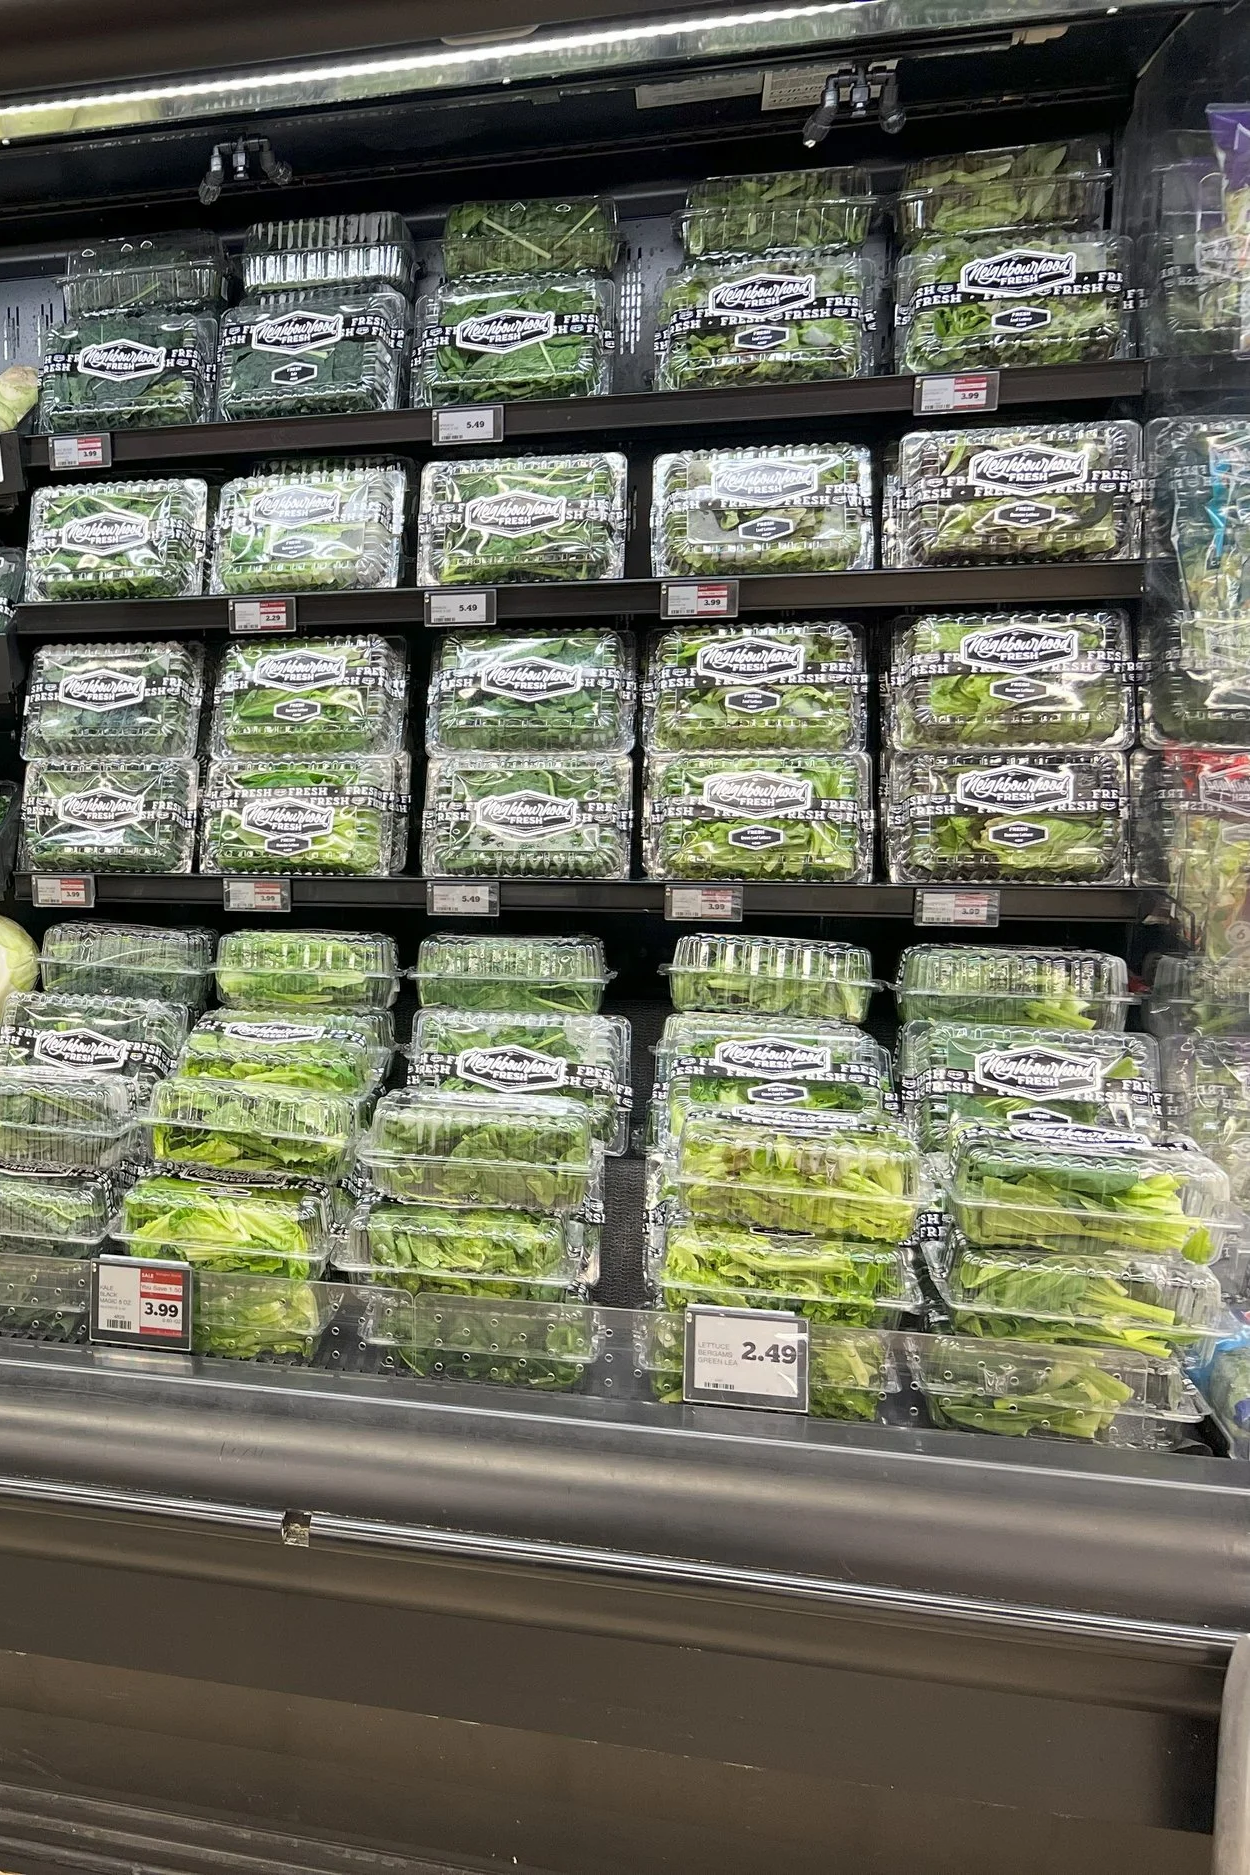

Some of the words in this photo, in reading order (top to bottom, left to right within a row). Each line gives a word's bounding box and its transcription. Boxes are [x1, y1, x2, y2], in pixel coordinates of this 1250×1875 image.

[970, 256, 1070, 282] Neighbourhood
[1000, 275, 1038, 285] FRESH
[715, 279, 811, 306] Neighbourhood
[1053, 284, 1103, 295] FRESH
[745, 298, 781, 308] FRESH
[785, 308, 831, 320] FRESH
[257, 317, 339, 342] Neighbourhood
[462, 317, 549, 340] Neighbourhood
[281, 334, 310, 344] FRESH
[489, 333, 521, 342] FRESH
[85, 348, 161, 367] Neighbourhood
[106, 363, 135, 371] FRESH
[961, 392, 979, 400] 3.99
[466, 420, 485, 429] 5.49
[977, 454, 1081, 479] Neighbourhood
[1009, 472, 1050, 482] FRESH
[747, 485, 782, 494] FRESH
[472, 501, 559, 523] Neighbourhood
[498, 516, 531, 525] FRESH
[968, 634, 1071, 658] Neighbourhood
[703, 645, 800, 668] Neighbourhood
[1000, 651, 1038, 661] FRESH
[260, 660, 340, 680] Neighbourhood
[732, 663, 768, 671] FRESH
[284, 673, 314, 681] FRESH
[486, 665, 576, 686] Neighbourhood
[65, 679, 140, 697] Neighbourhood
[513, 681, 547, 690] FRESH
[87, 693, 115, 701] FRESH
[966, 773, 1069, 797] Neighbourhood
[234, 789, 271, 798] FRESH
[288, 787, 327, 797] FRESH
[711, 780, 808, 802] Neighbourhood
[996, 791, 1035, 801] FRESH
[65, 797, 138, 816] Neighbourhood
[310, 797, 349, 806] FRESH
[740, 798, 775, 807] FRESH
[483, 800, 571, 820] Neighbourhood
[87, 812, 115, 820] FRESH
[248, 805, 329, 827] Neighbourhood
[510, 816, 543, 824] FRESH
[271, 823, 303, 831] FRESH
[42, 1035, 122, 1060] Neighbourhood
[64, 1052, 94, 1062] FRESH
[724, 1044, 825, 1065] Neighbourhood
[464, 1050, 561, 1077] Neighbourhood
[755, 1060, 790, 1068] FRESH
[984, 1055, 1095, 1080] Neighbourhood
[492, 1070, 528, 1080] FRESH
[1017, 1077, 1059, 1087] FRESH
[144, 1302, 179, 1317] 3.99
[698, 1342, 730, 1350] LETTUCE
[742, 1341, 797, 1364] 2.49
[698, 1356, 723, 1365] GREEN
